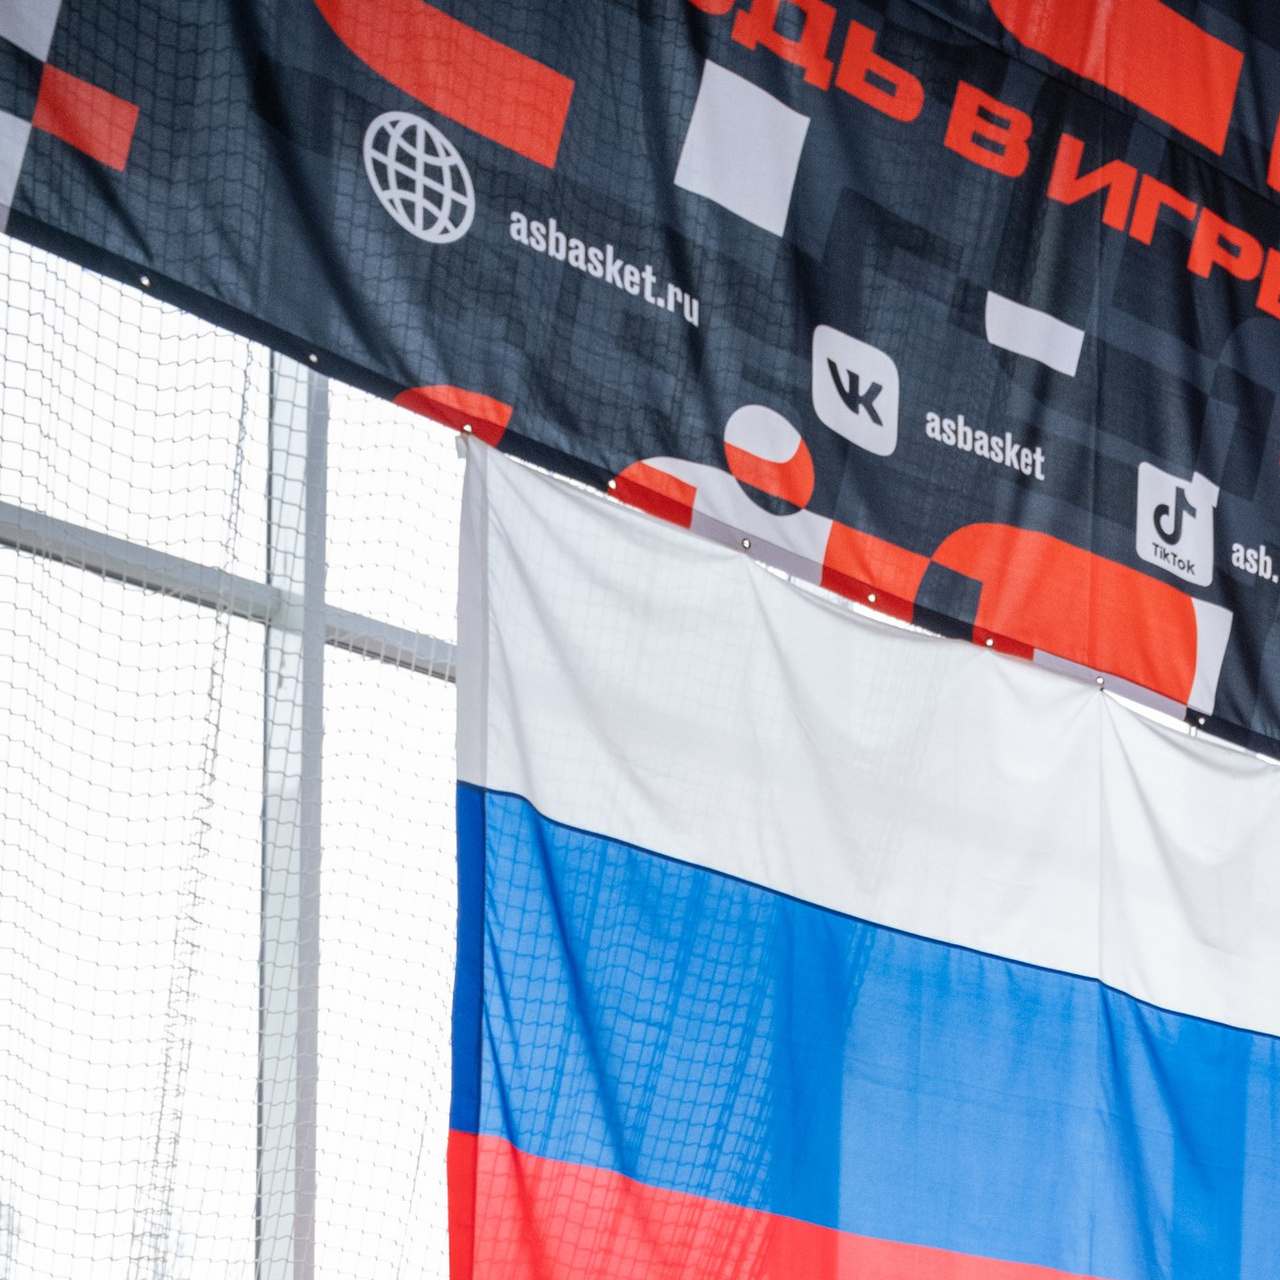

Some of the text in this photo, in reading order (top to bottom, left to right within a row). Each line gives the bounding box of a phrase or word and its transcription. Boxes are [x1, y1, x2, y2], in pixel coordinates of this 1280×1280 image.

[944, 80, 1033, 178] В
[509, 211, 699, 327] asbasket.ru
[925, 411, 1045, 481] asbasket
[1152, 542, 1196, 576] TikTok
